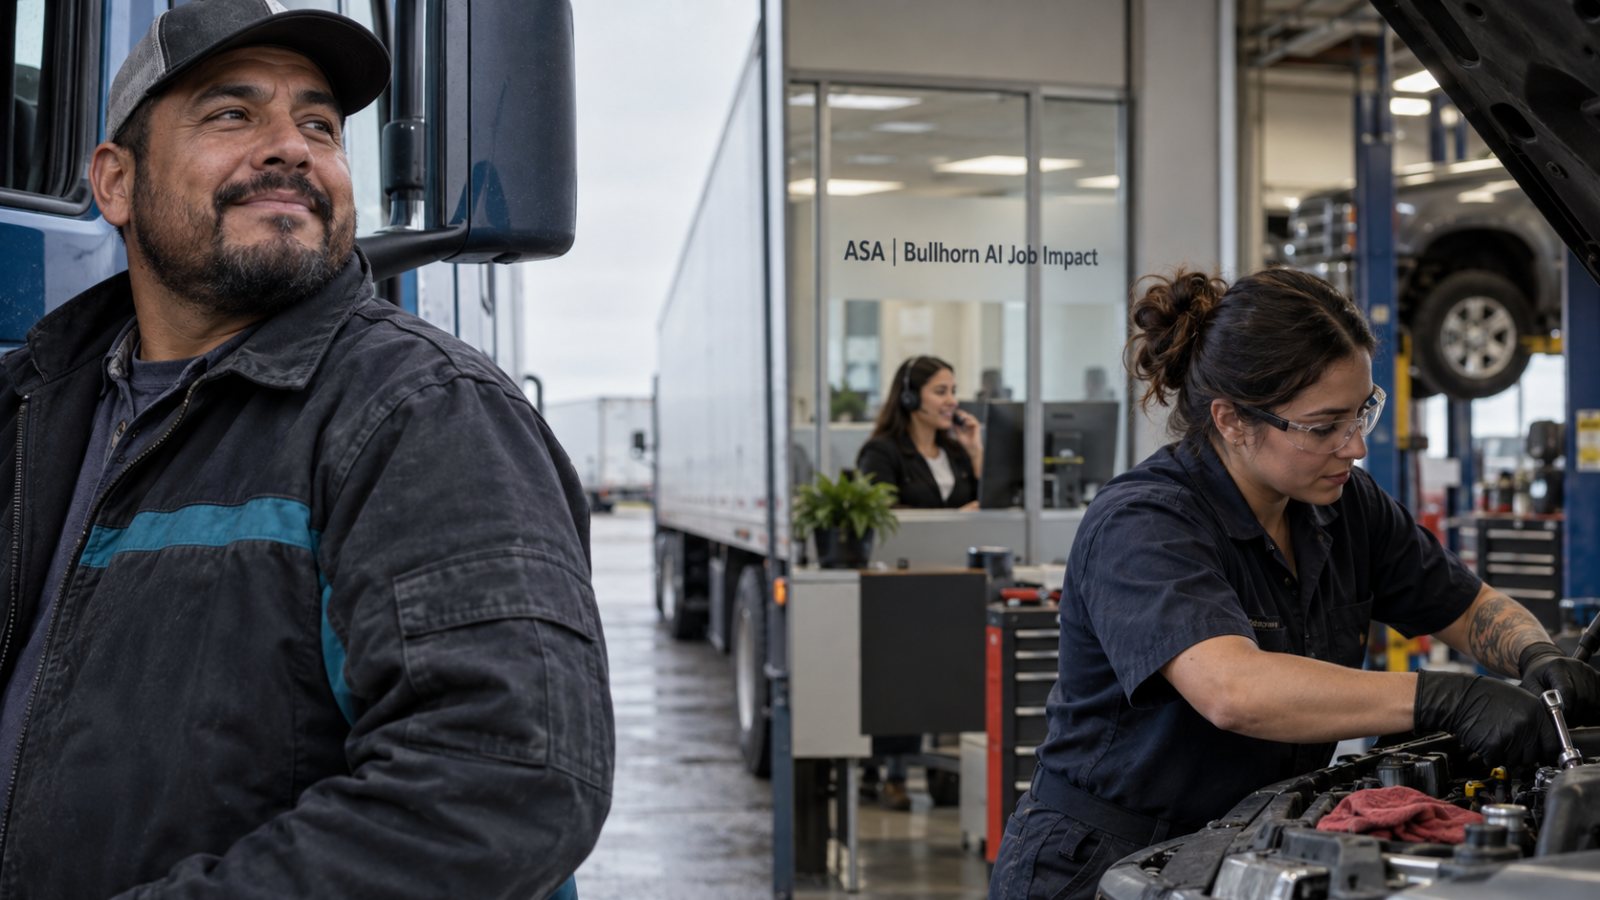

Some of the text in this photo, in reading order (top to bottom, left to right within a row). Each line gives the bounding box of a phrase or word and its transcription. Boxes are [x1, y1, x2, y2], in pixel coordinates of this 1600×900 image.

[844, 240, 885, 262] ASA
[904, 241, 979, 264] Bullhorn
[985, 243, 1002, 264] AI
[1008, 245, 1038, 265] Job
[1043, 245, 1098, 270] Impact
